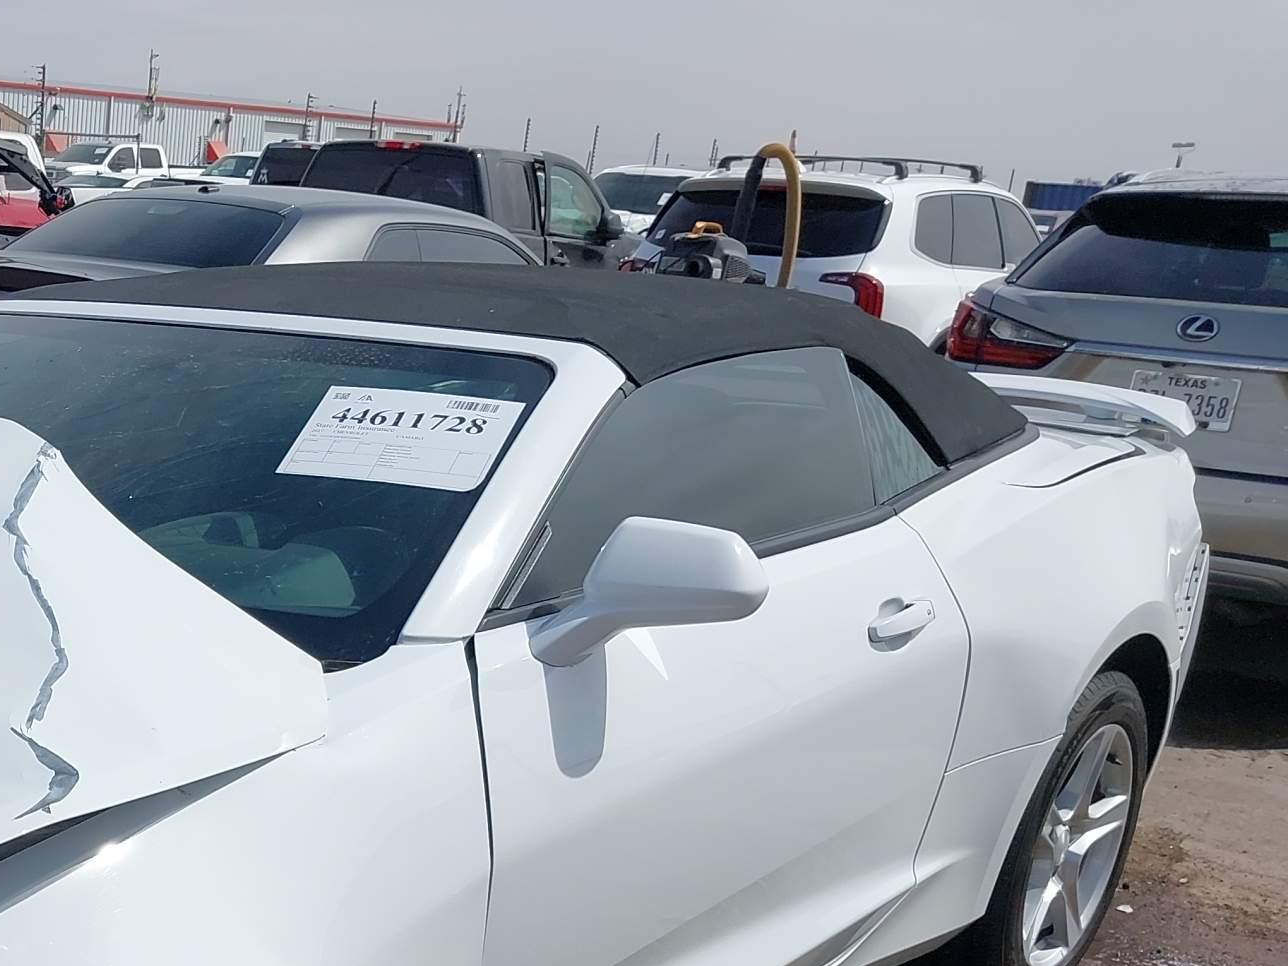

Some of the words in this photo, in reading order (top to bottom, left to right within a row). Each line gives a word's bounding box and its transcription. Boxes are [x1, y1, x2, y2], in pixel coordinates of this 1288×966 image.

[1168, 376, 1207, 390] TEXAS
[1183, 393, 1230, 419] 7358
[331, 407, 488, 435] 44611728
